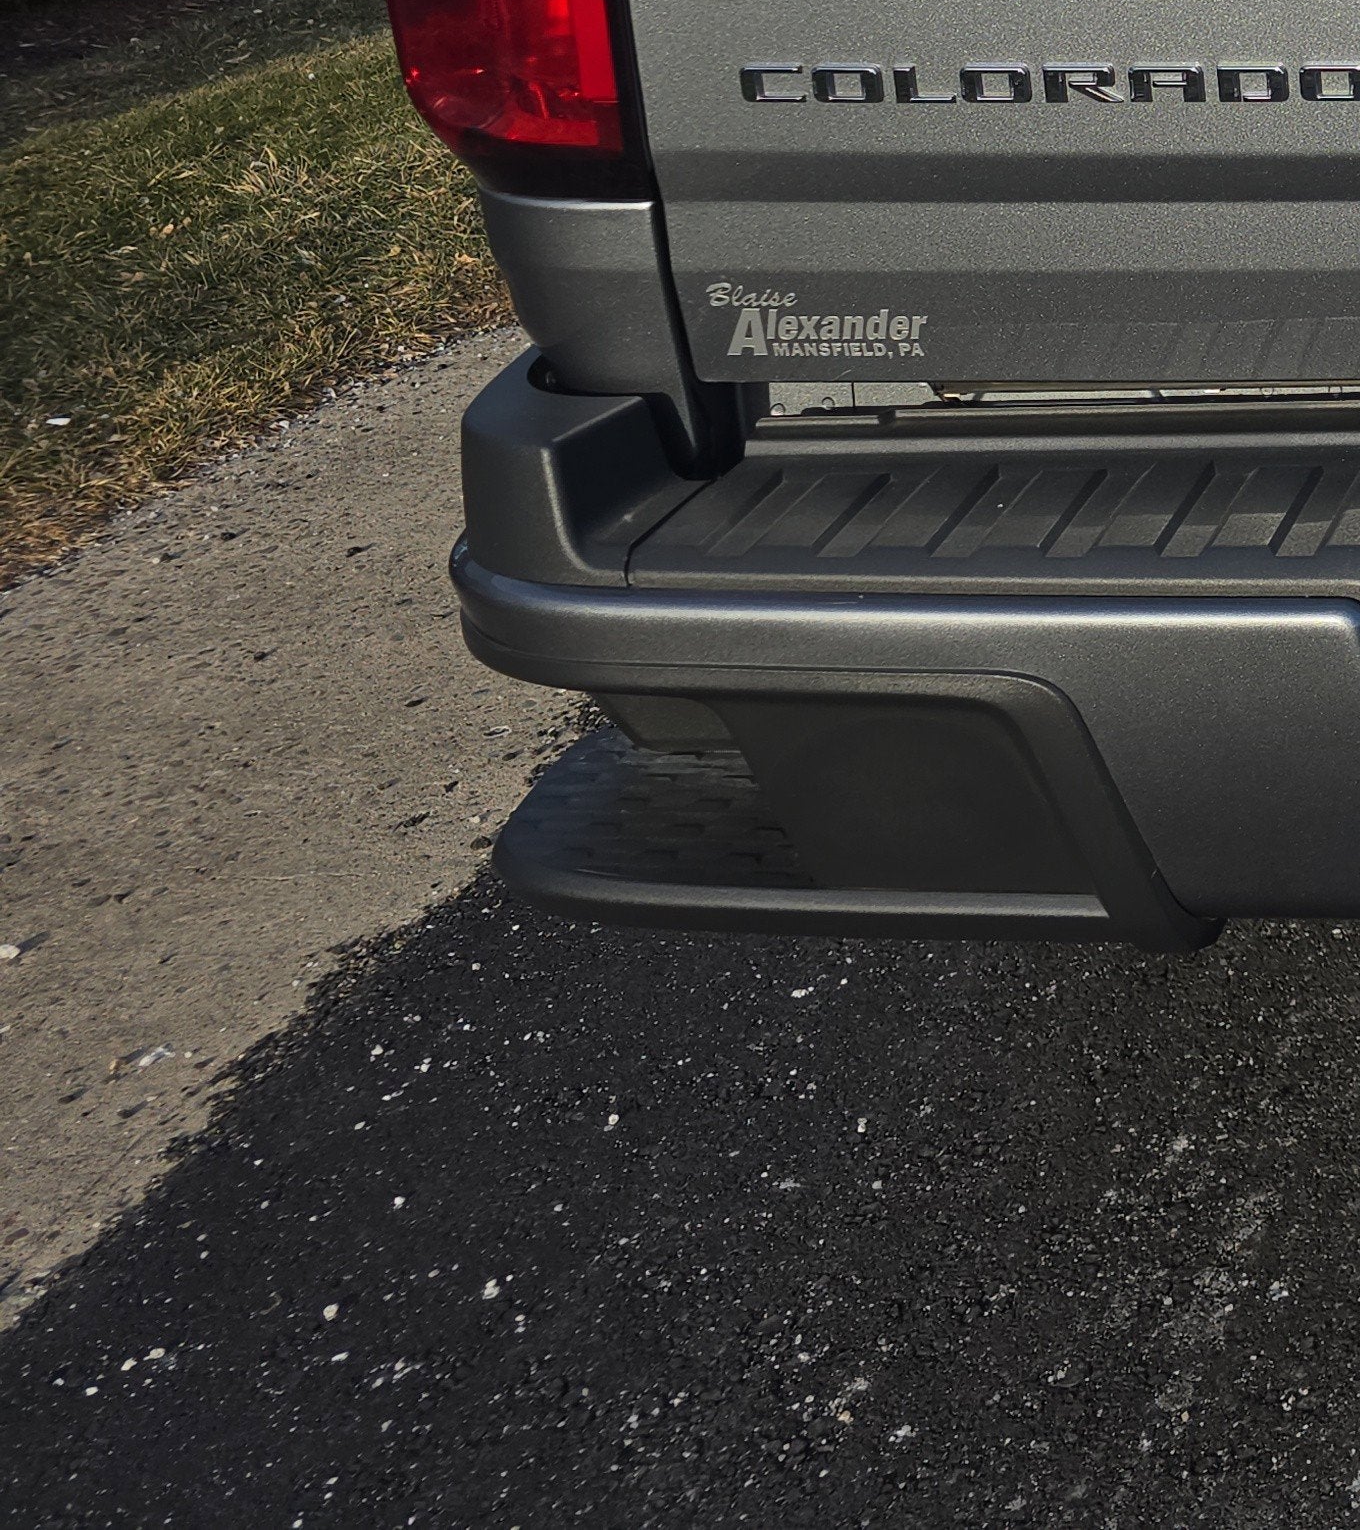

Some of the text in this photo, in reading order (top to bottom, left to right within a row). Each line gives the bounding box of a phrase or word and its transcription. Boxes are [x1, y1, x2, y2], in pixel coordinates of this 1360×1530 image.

[705, 282, 798, 307] Blaise
[727, 308, 928, 356] Alexander
[772, 342, 925, 359] MANSFIELD, PA
